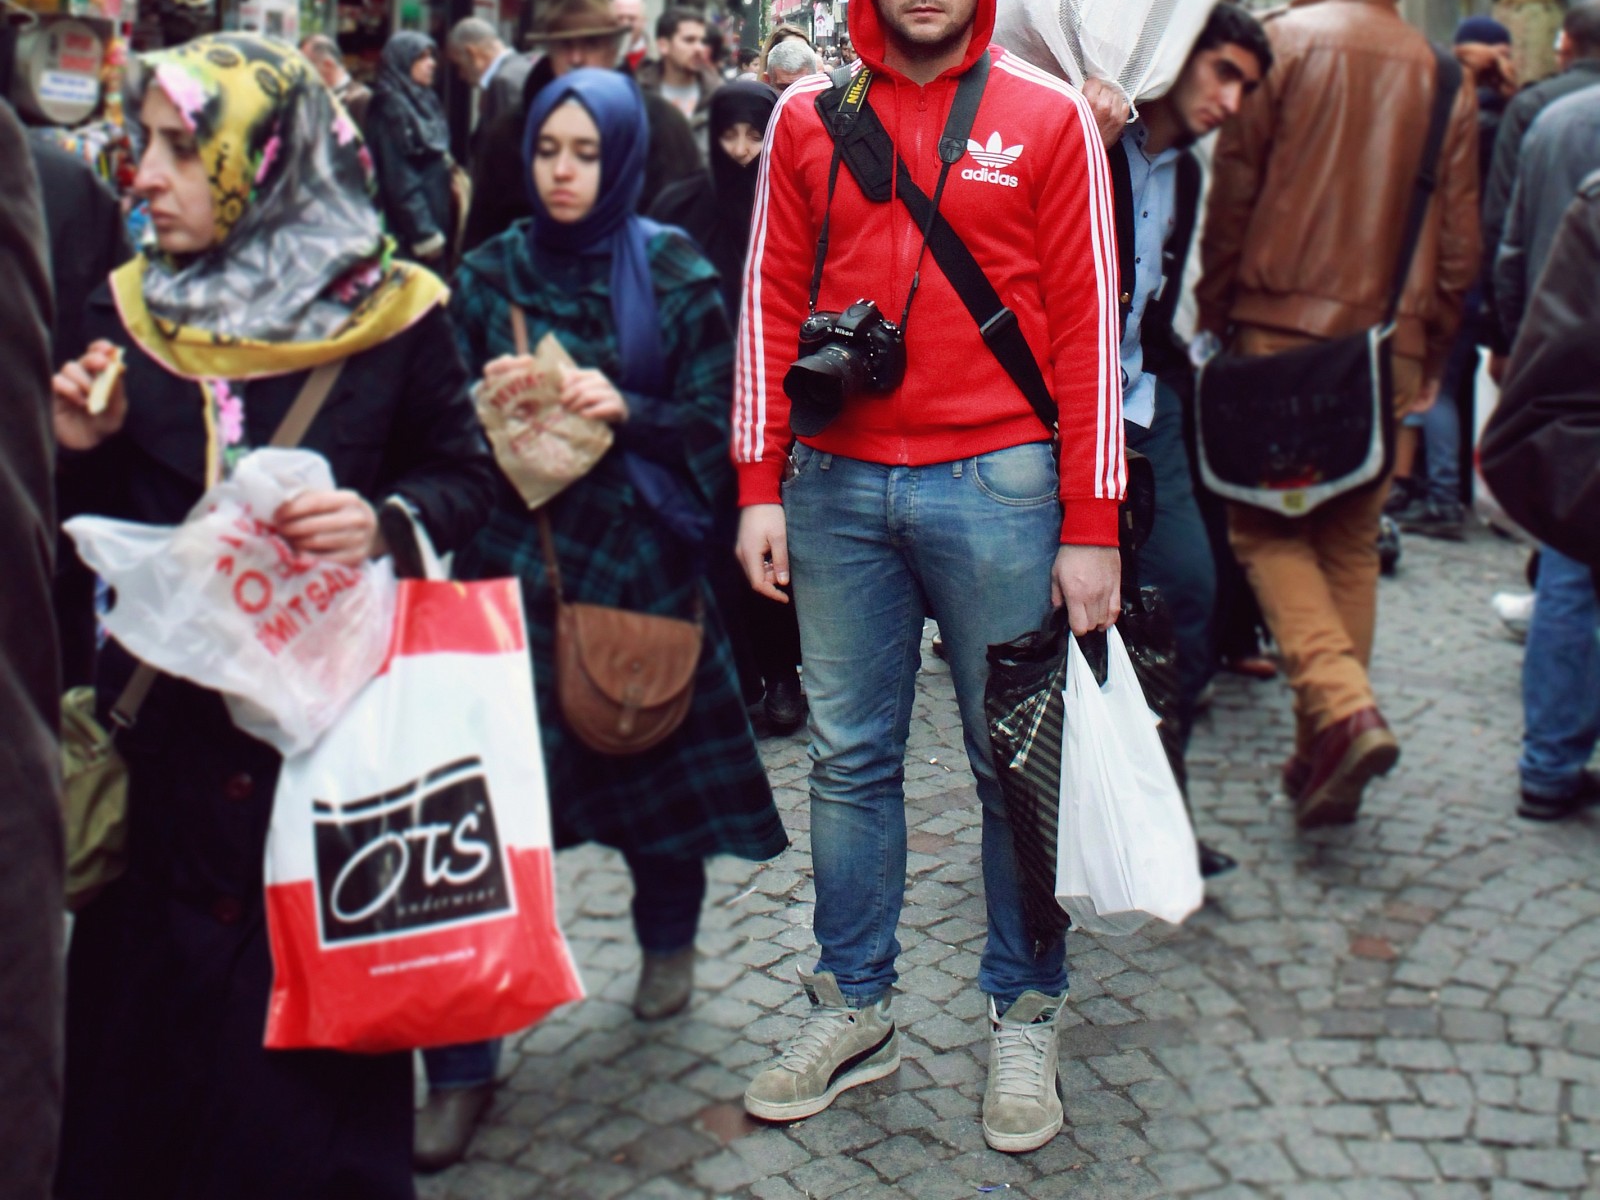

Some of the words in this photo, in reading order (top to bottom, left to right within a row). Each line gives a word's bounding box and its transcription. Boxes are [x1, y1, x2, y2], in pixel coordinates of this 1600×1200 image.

[846, 69, 871, 104] Nikon
[961, 167, 1018, 187] adidas
[834, 327, 854, 337] Nikon
